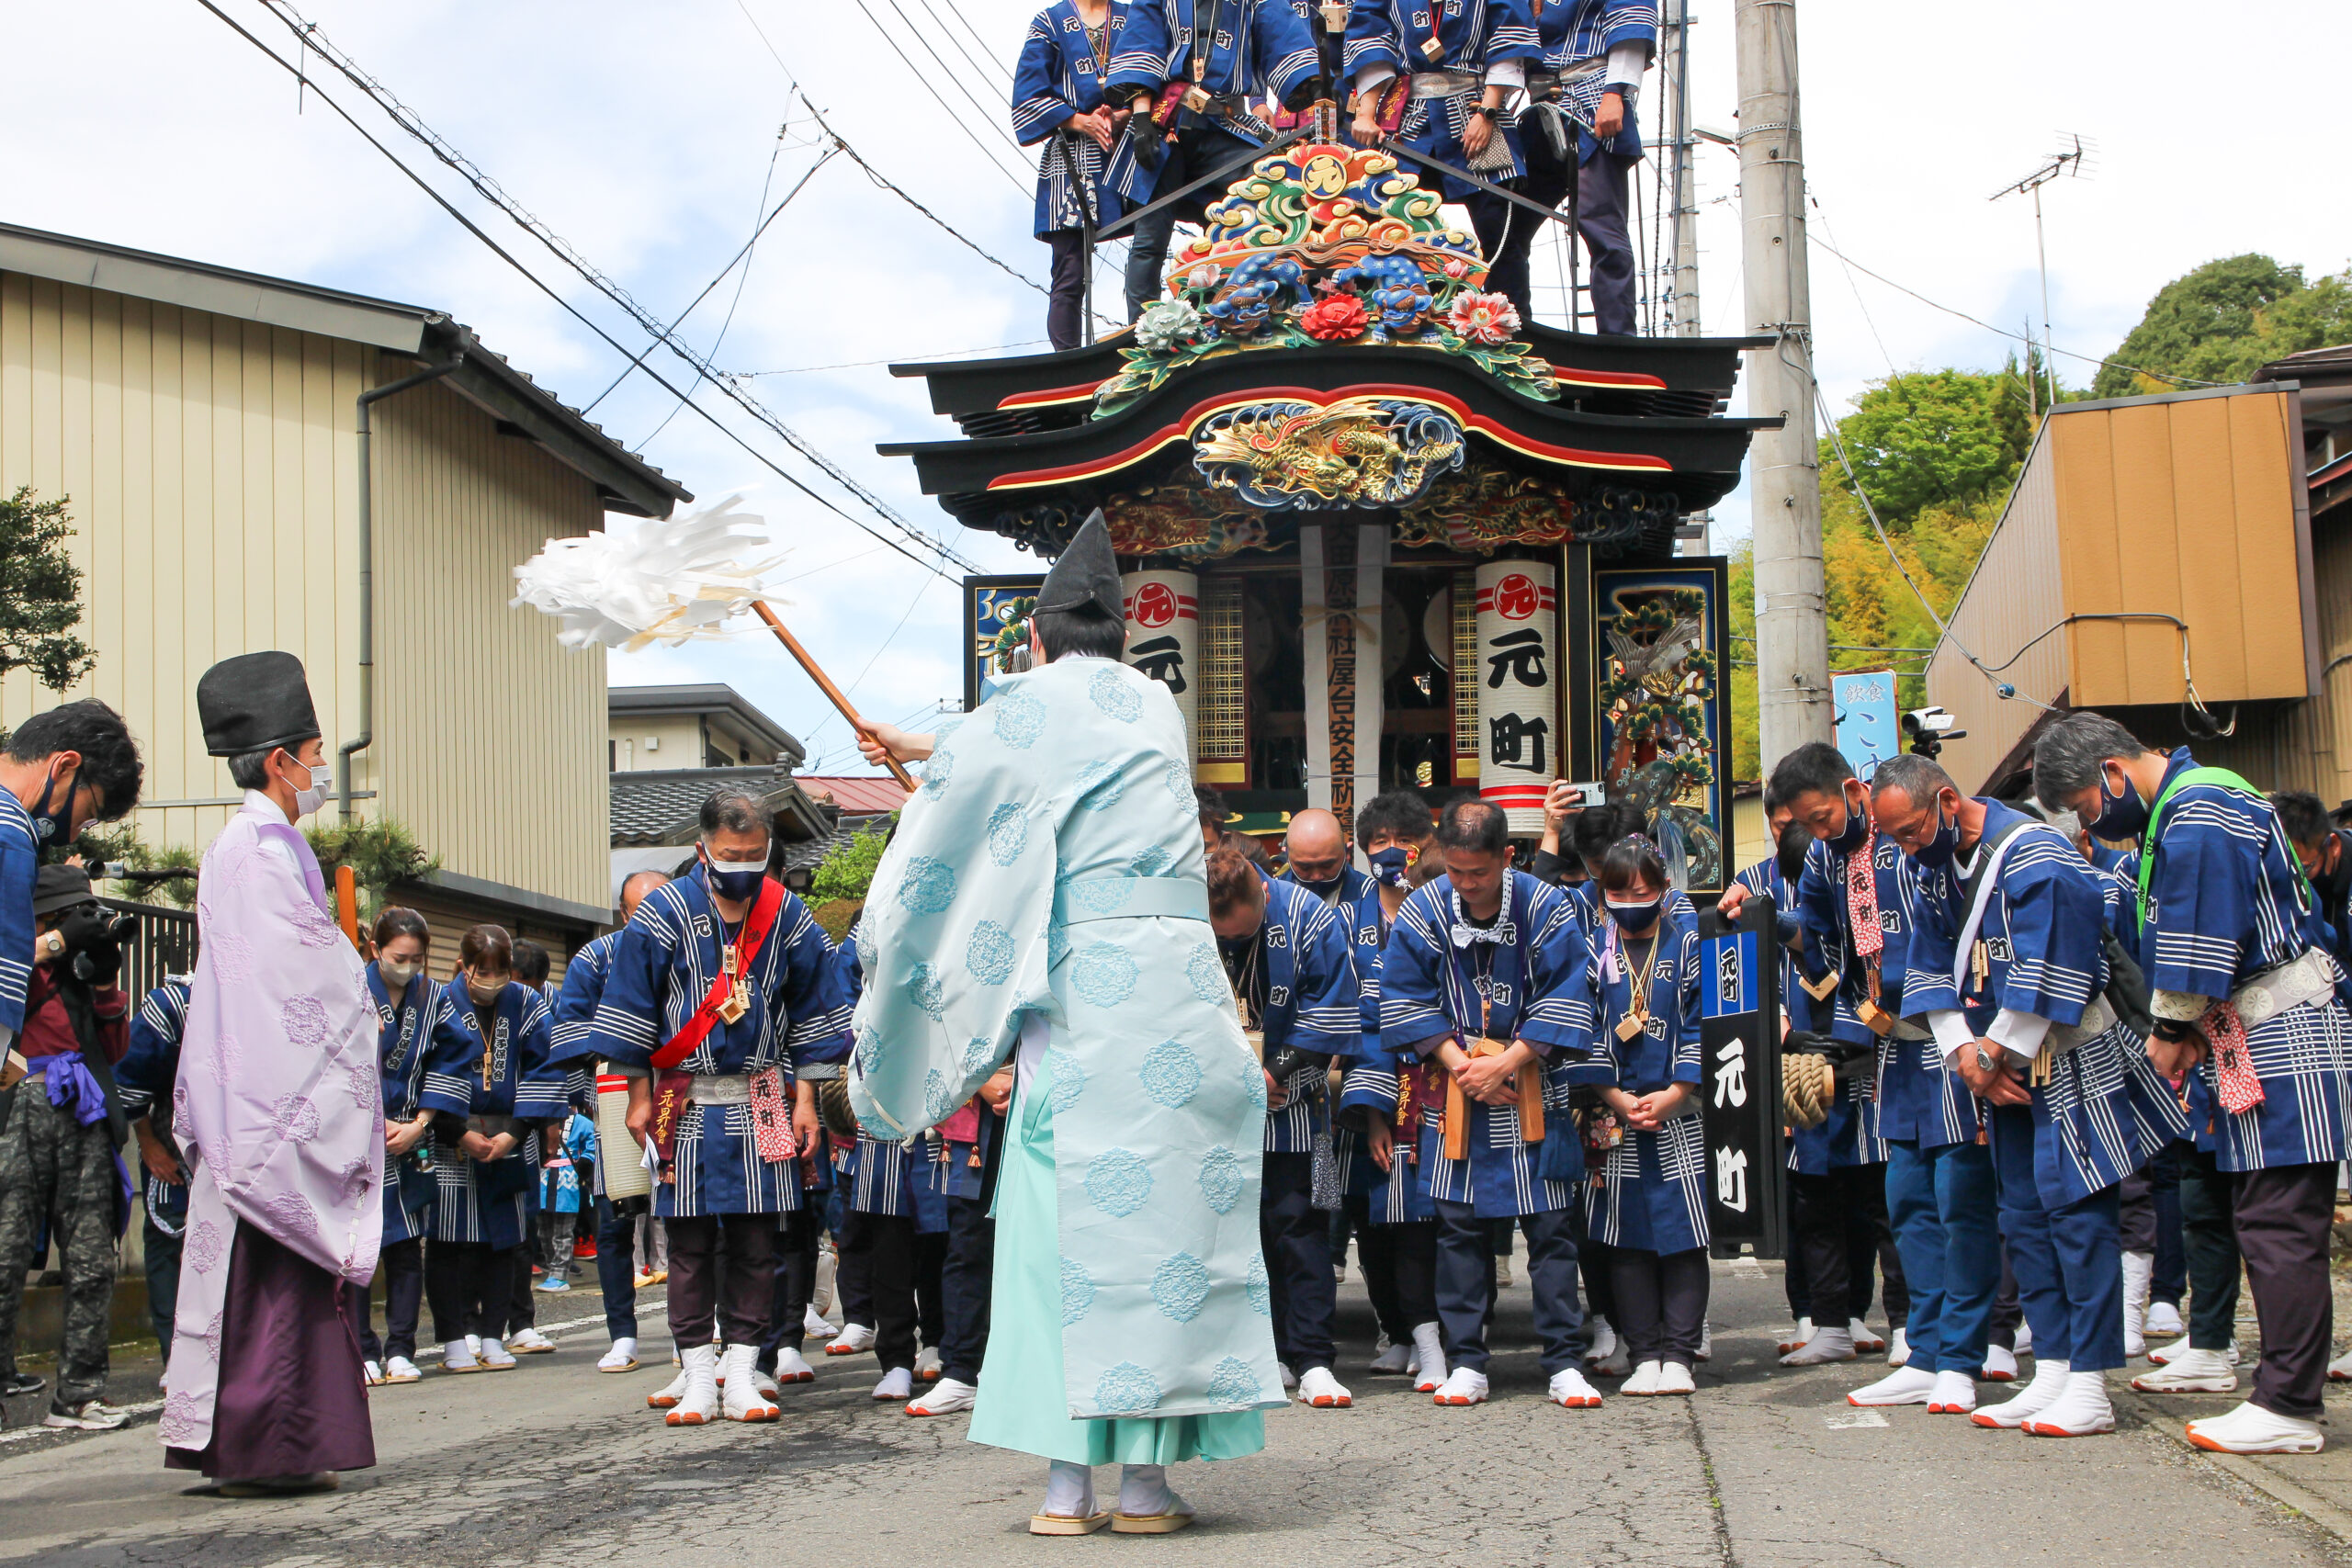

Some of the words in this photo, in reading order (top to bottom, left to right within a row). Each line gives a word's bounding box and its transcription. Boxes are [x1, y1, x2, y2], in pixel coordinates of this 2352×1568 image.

[1412, 11, 1430, 28] 町
[1487, 628, 1548, 774] 元町
[1845, 682, 1885, 703] 飲食
[1852, 872, 1871, 921] 元町
[1359, 925, 1377, 946] 元
[1986, 937, 2012, 962] 町
[1721, 946, 1738, 1002] 元町
[757, 1078, 775, 1127] 元町
[1714, 1037, 1747, 1213] 元町
